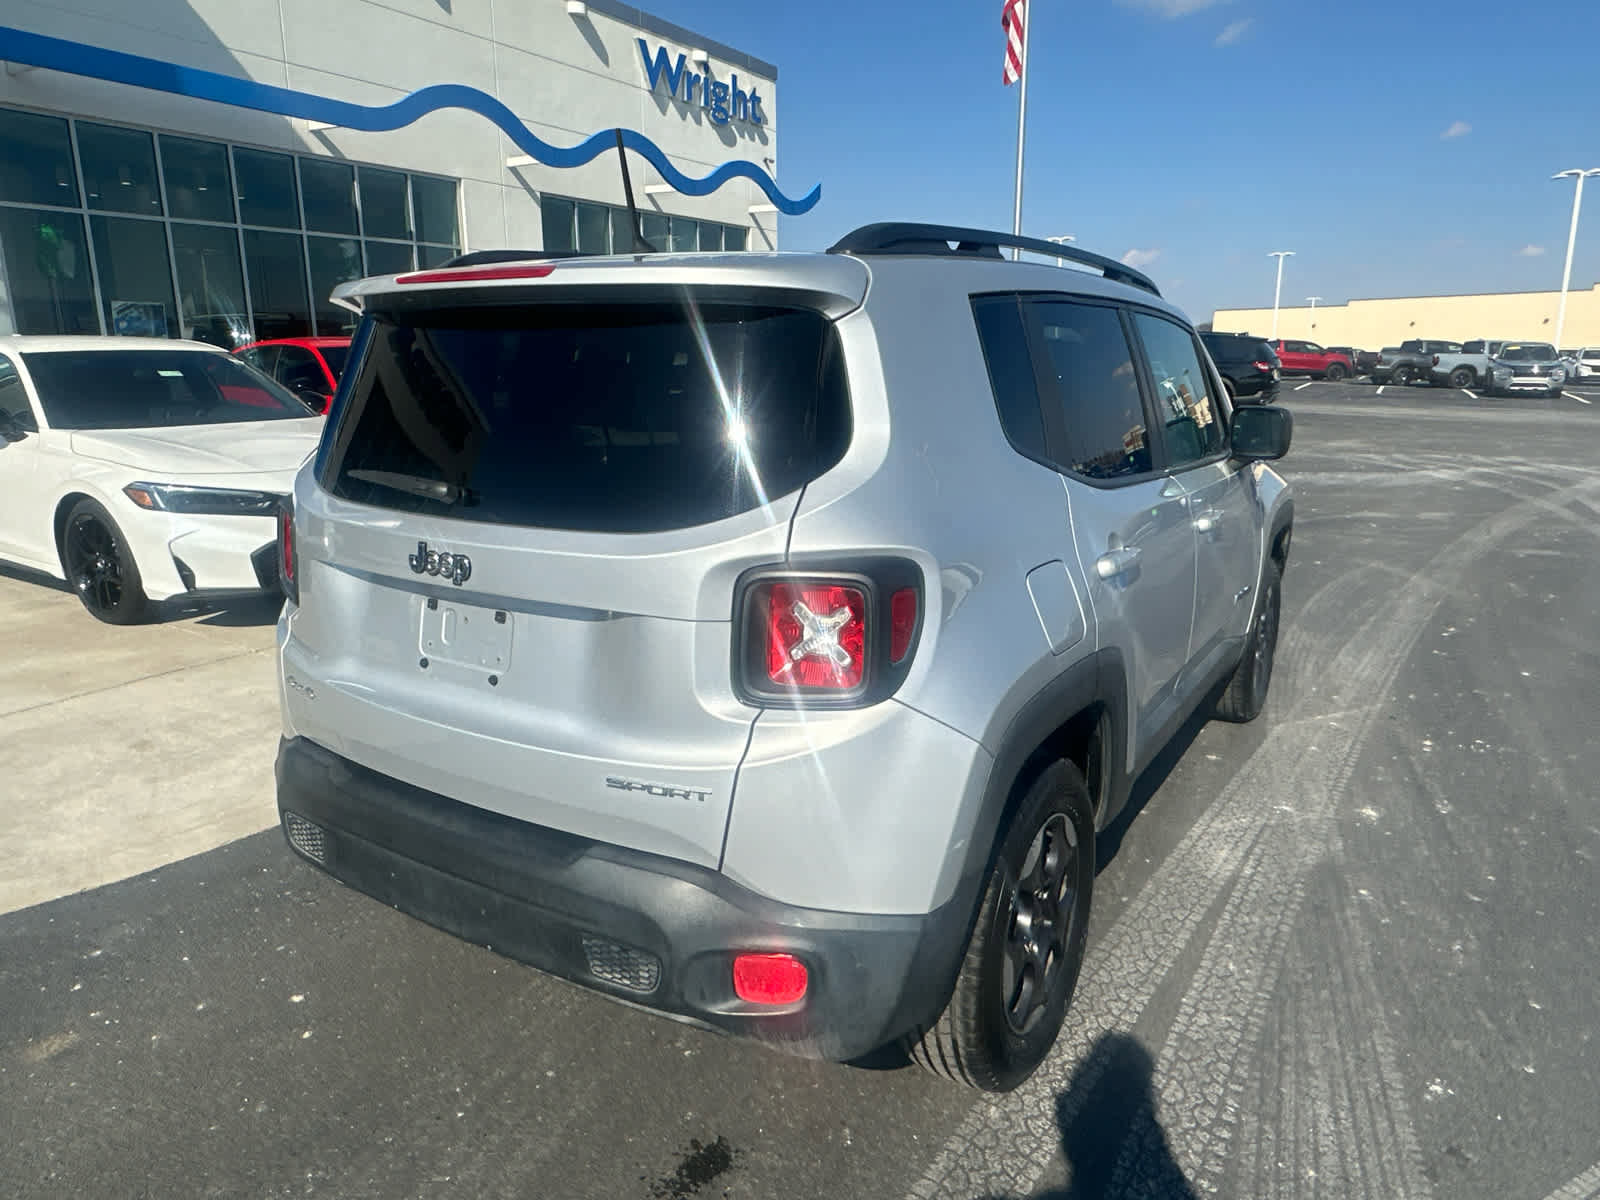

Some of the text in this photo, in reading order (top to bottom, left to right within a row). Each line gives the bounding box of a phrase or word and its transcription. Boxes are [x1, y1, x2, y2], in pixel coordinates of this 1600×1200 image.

[638, 38, 762, 125] Wright
[409, 541, 472, 586] Jeep
[606, 777, 712, 802] SPORT
